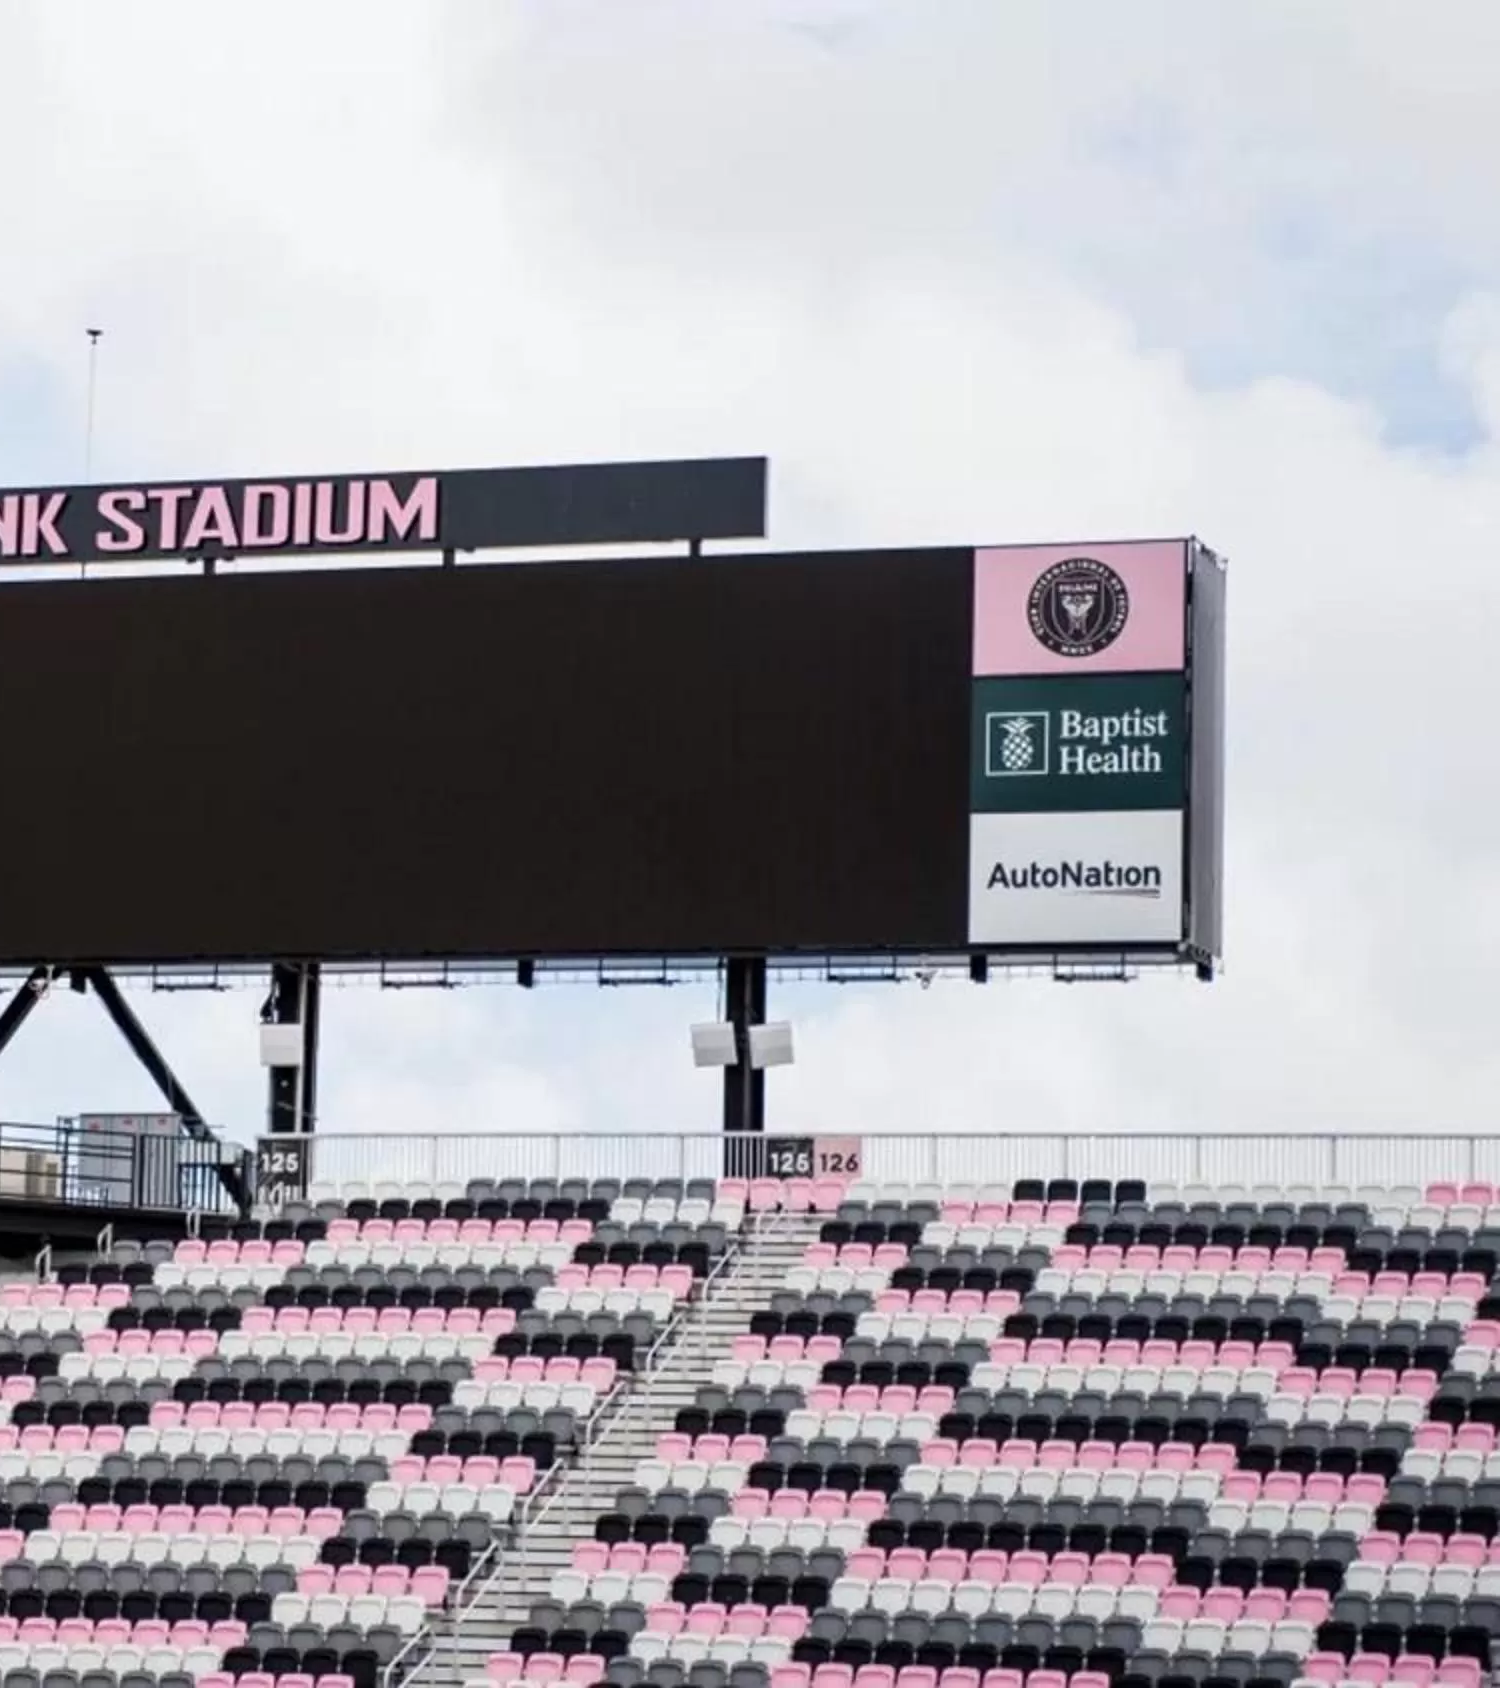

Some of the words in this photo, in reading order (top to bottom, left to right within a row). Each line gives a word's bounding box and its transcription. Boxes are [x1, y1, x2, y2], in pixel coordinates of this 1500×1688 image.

[95, 477, 438, 552] STADIUM
[1059, 707, 1169, 746] Baptist
[1059, 743, 1162, 775] Health
[987, 861, 1161, 889] AutoNation
[821, 1152, 859, 1173] 126
